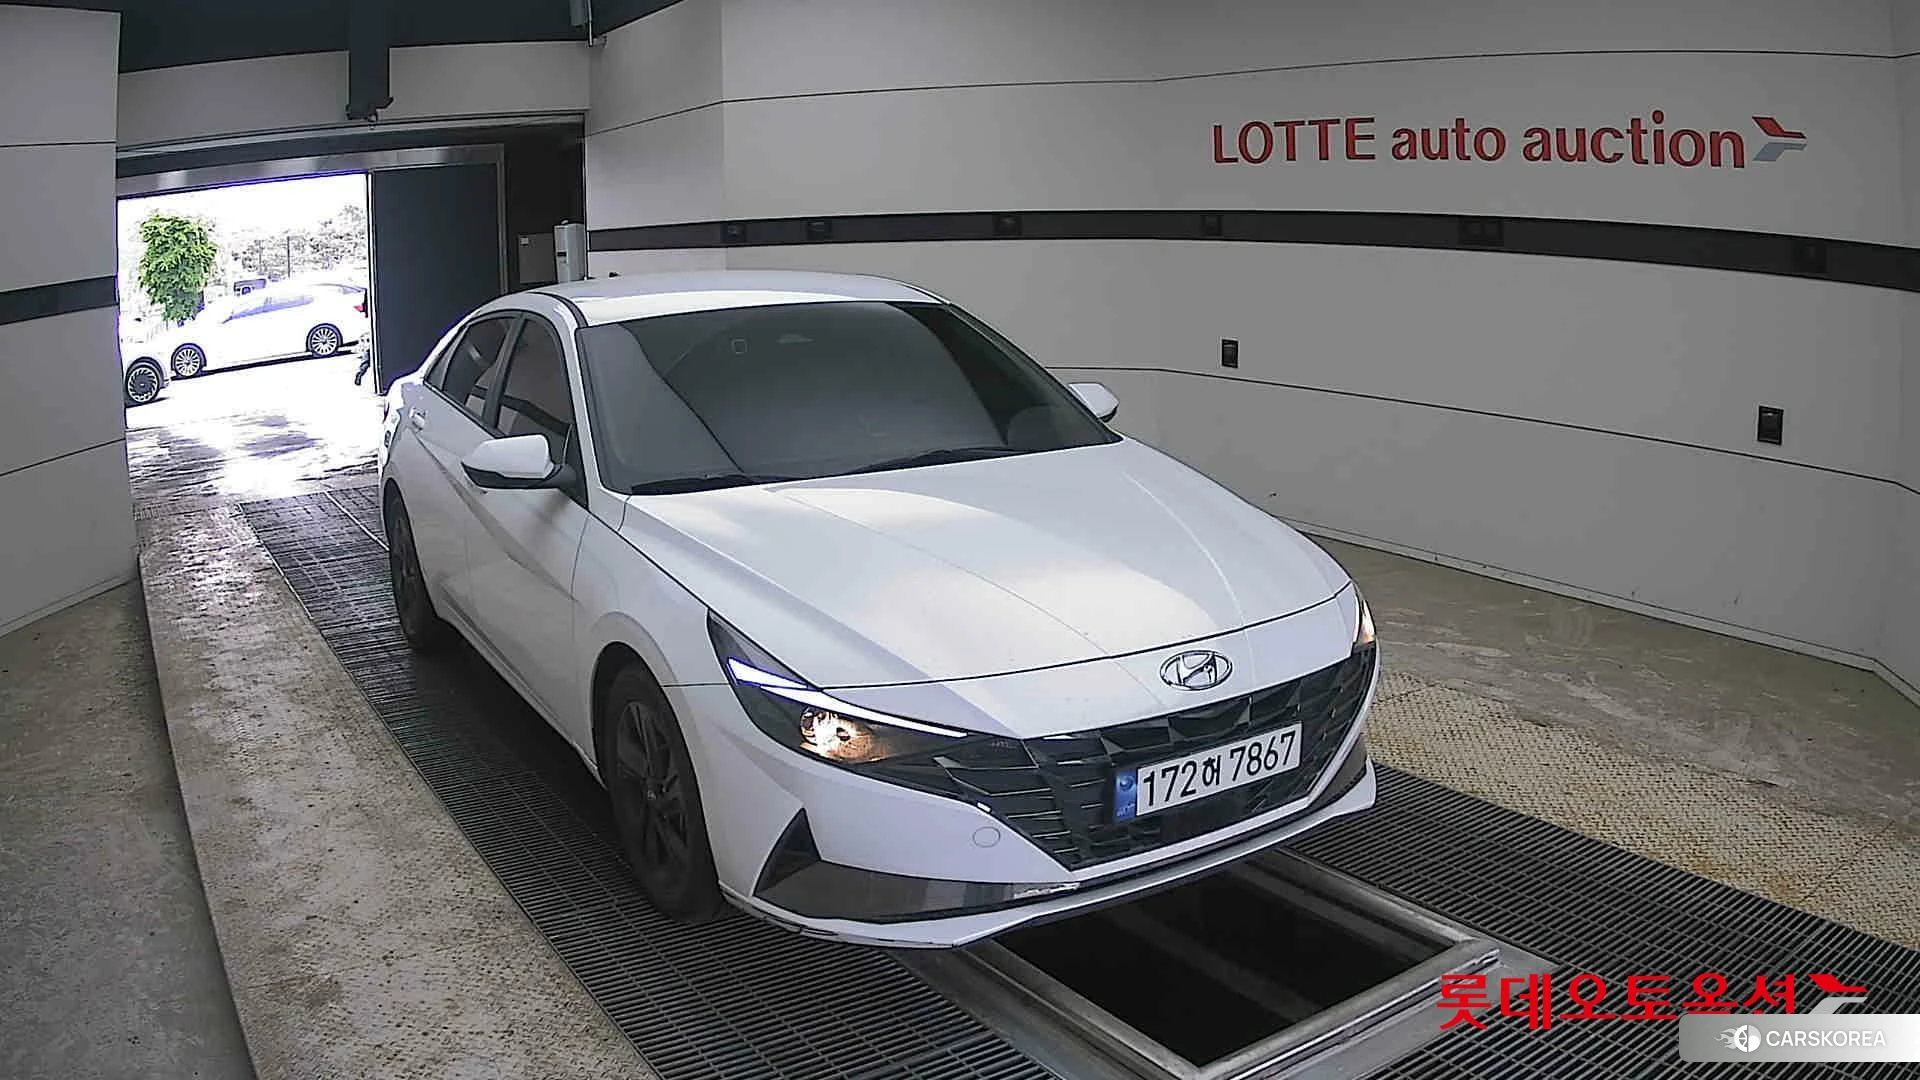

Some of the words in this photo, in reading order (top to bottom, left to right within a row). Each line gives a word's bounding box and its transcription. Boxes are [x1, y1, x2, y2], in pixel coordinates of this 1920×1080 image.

[1213, 117, 1376, 164] LOTTE
[1392, 118, 1507, 161] auto
[1523, 111, 1746, 168] auction
[1143, 755, 1221, 806] 172허
[1230, 731, 1296, 782] 7867
